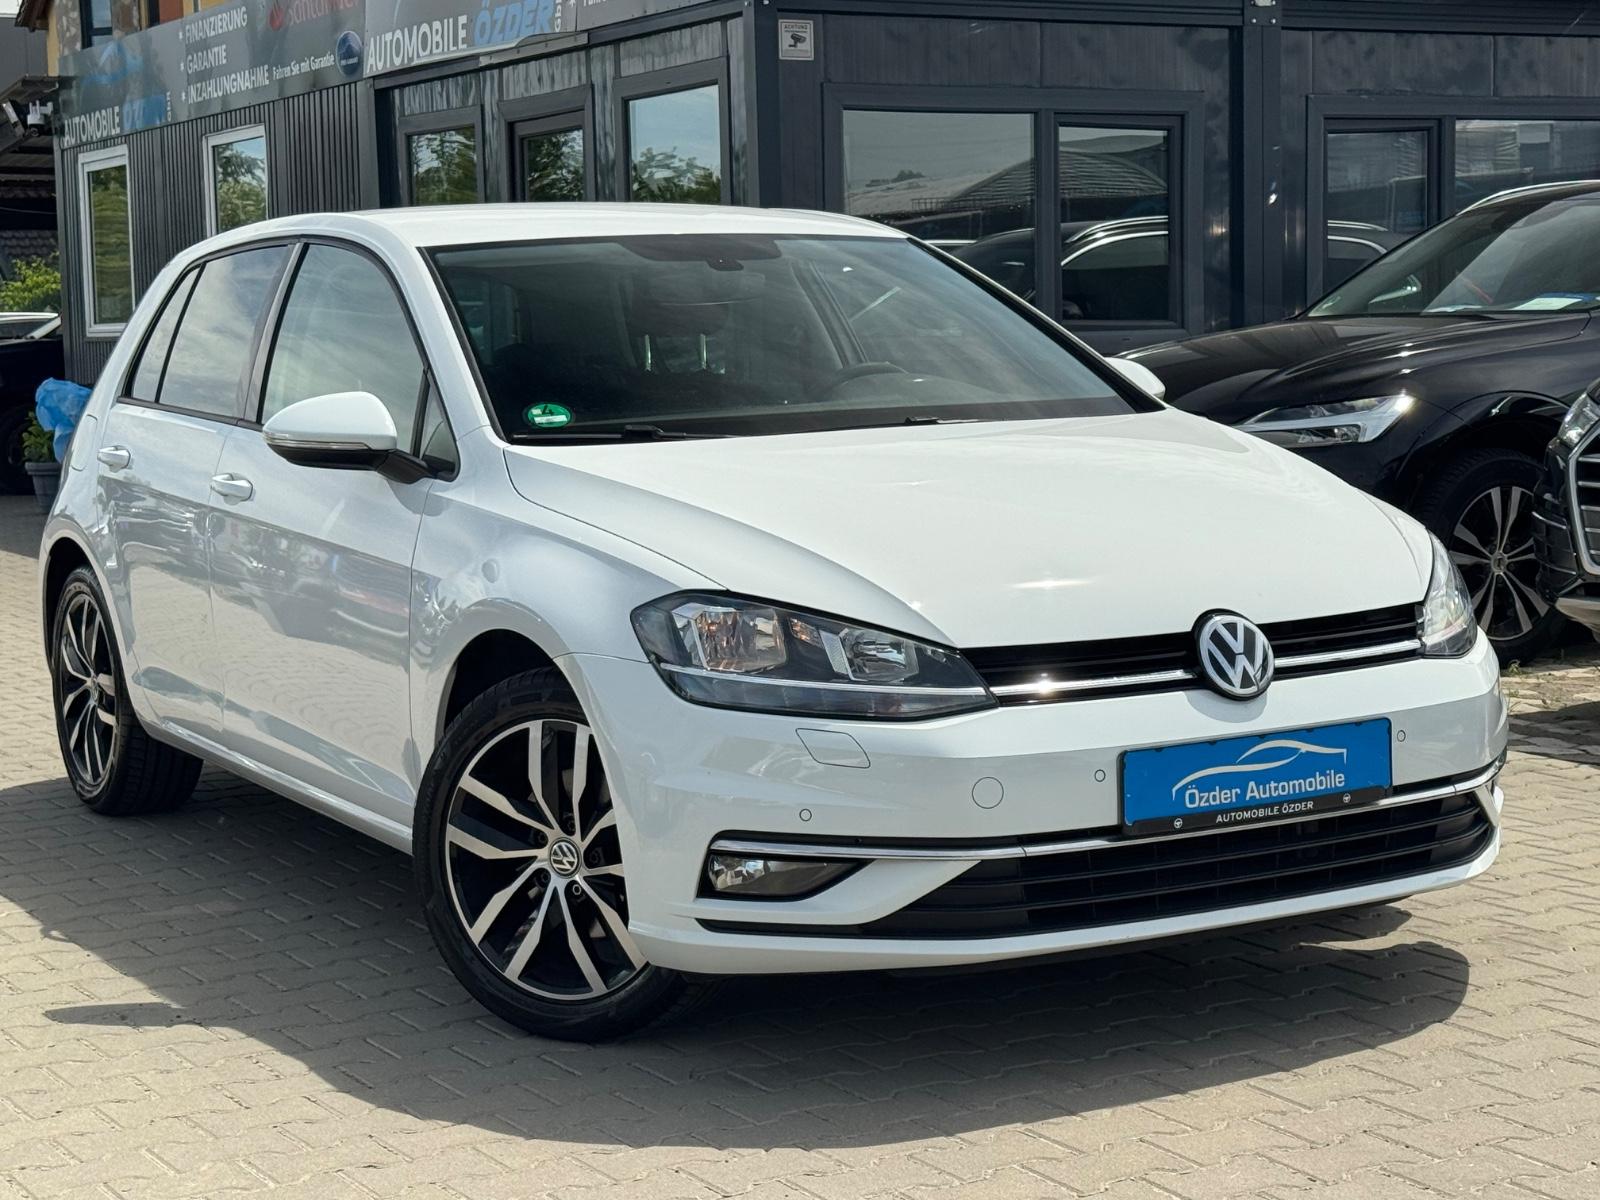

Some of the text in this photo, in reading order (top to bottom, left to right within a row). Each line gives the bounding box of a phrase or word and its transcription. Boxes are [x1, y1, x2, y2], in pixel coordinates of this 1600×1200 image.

[185, 6, 248, 44] FINANZIERUNG
[366, 0, 555, 73] AUTOMOBILE ÖZDER
[186, 44, 227, 74] GARANTIE
[273, 64, 291, 80] Fahren
[291, 60, 300, 76] Sie
[300, 57, 310, 73] mit
[310, 51, 335, 71] Garantie
[188, 64, 269, 104] INZAHLUNGNAHME
[64, 106, 120, 146] AUTOMOBILE
[1185, 769, 1345, 809] Özder Automobile
[1216, 800, 1314, 823] AUTOMOBILE ÖZDER
